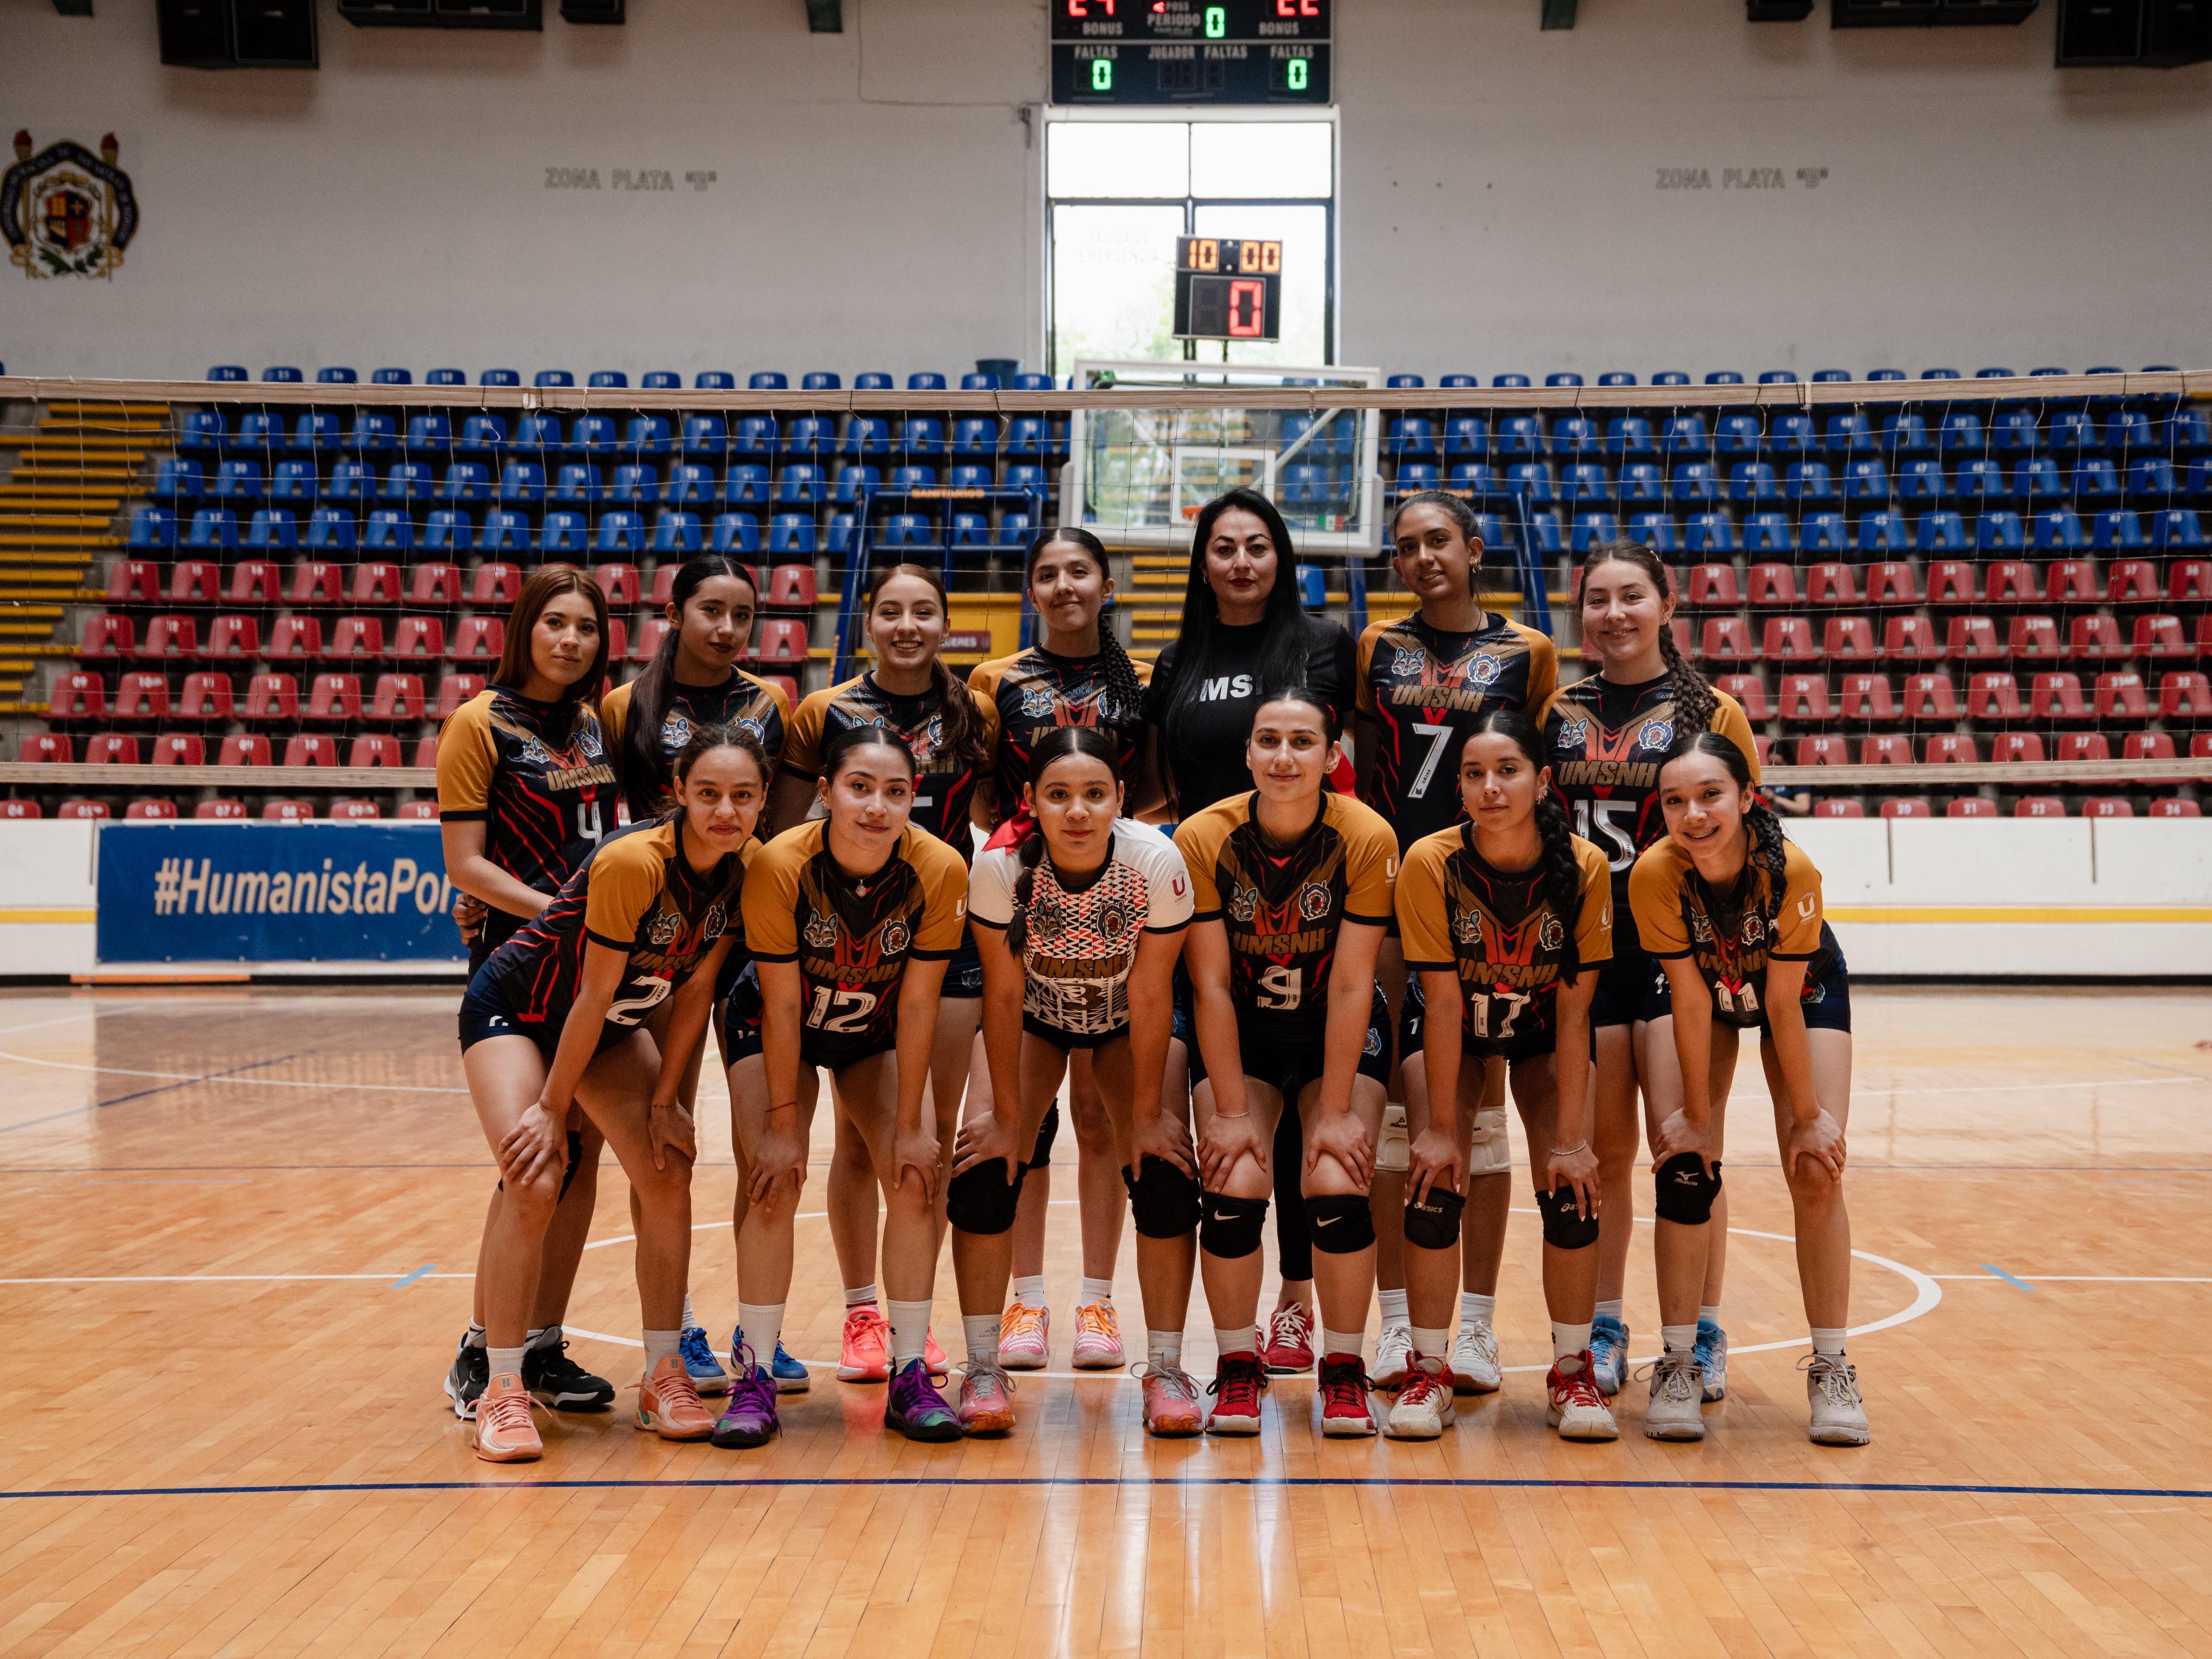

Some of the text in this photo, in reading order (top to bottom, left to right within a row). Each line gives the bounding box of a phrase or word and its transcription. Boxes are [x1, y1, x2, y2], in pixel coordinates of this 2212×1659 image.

[1082, 22, 1123, 36] BONUS
[1147, 13, 1201, 27] PERIODO
[1205, 7, 1225, 38] 0
[1259, 21, 1299, 36] BONUS
[1074, 45, 1118, 60] FALTAS
[1204, 45, 1248, 60] FALTAS
[1270, 45, 1314, 59] FALTAS
[1092, 59, 1112, 90] 0
[1287, 58, 1308, 90] 0
[543, 166, 601, 190] ZONA
[611, 168, 674, 191] PLATA
[1655, 167, 1712, 190] ZONA
[1722, 167, 1786, 190] PLATA
[1228, 280, 1262, 337] 0
[1392, 684, 1484, 713] UMSNH
[1407, 723, 1454, 799] 7
[1559, 760, 1658, 787] UMSNH
[546, 763, 616, 792] UMSNH
[577, 801, 603, 847] 4
[1573, 799, 1636, 873] 15
[1233, 932, 1326, 956] UMSNH
[804, 958, 901, 984] UMSNH
[1030, 957, 1128, 979] UMSNH
[1459, 958, 1560, 987] UMSNH
[605, 976, 672, 1026] 2
[1257, 965, 1302, 1010] 9
[806, 985, 877, 1033] 12
[1471, 990, 1531, 1038] 17
